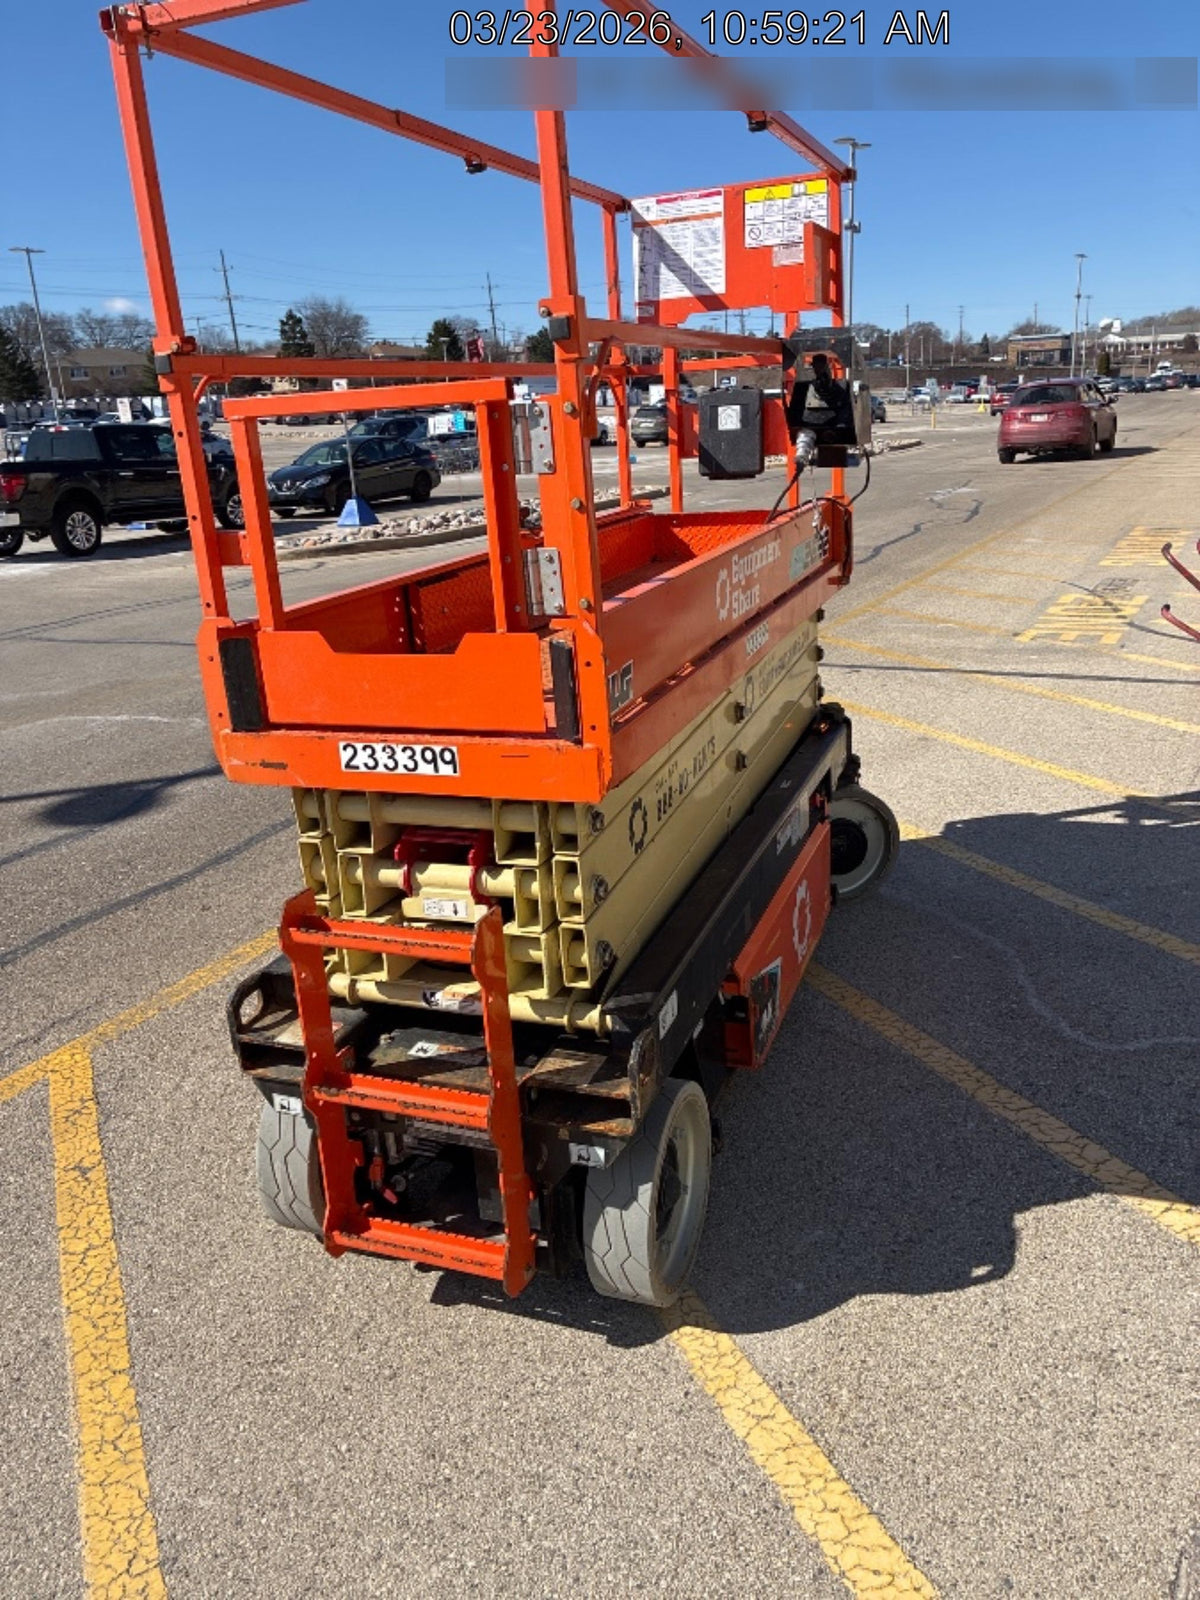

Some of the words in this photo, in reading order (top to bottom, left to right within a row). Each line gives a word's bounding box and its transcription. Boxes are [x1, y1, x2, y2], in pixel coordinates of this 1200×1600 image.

[732, 539, 781, 586] Equipment
[732, 584, 760, 619] Share
[607, 659, 634, 716] LG
[342, 743, 458, 774] 233399
